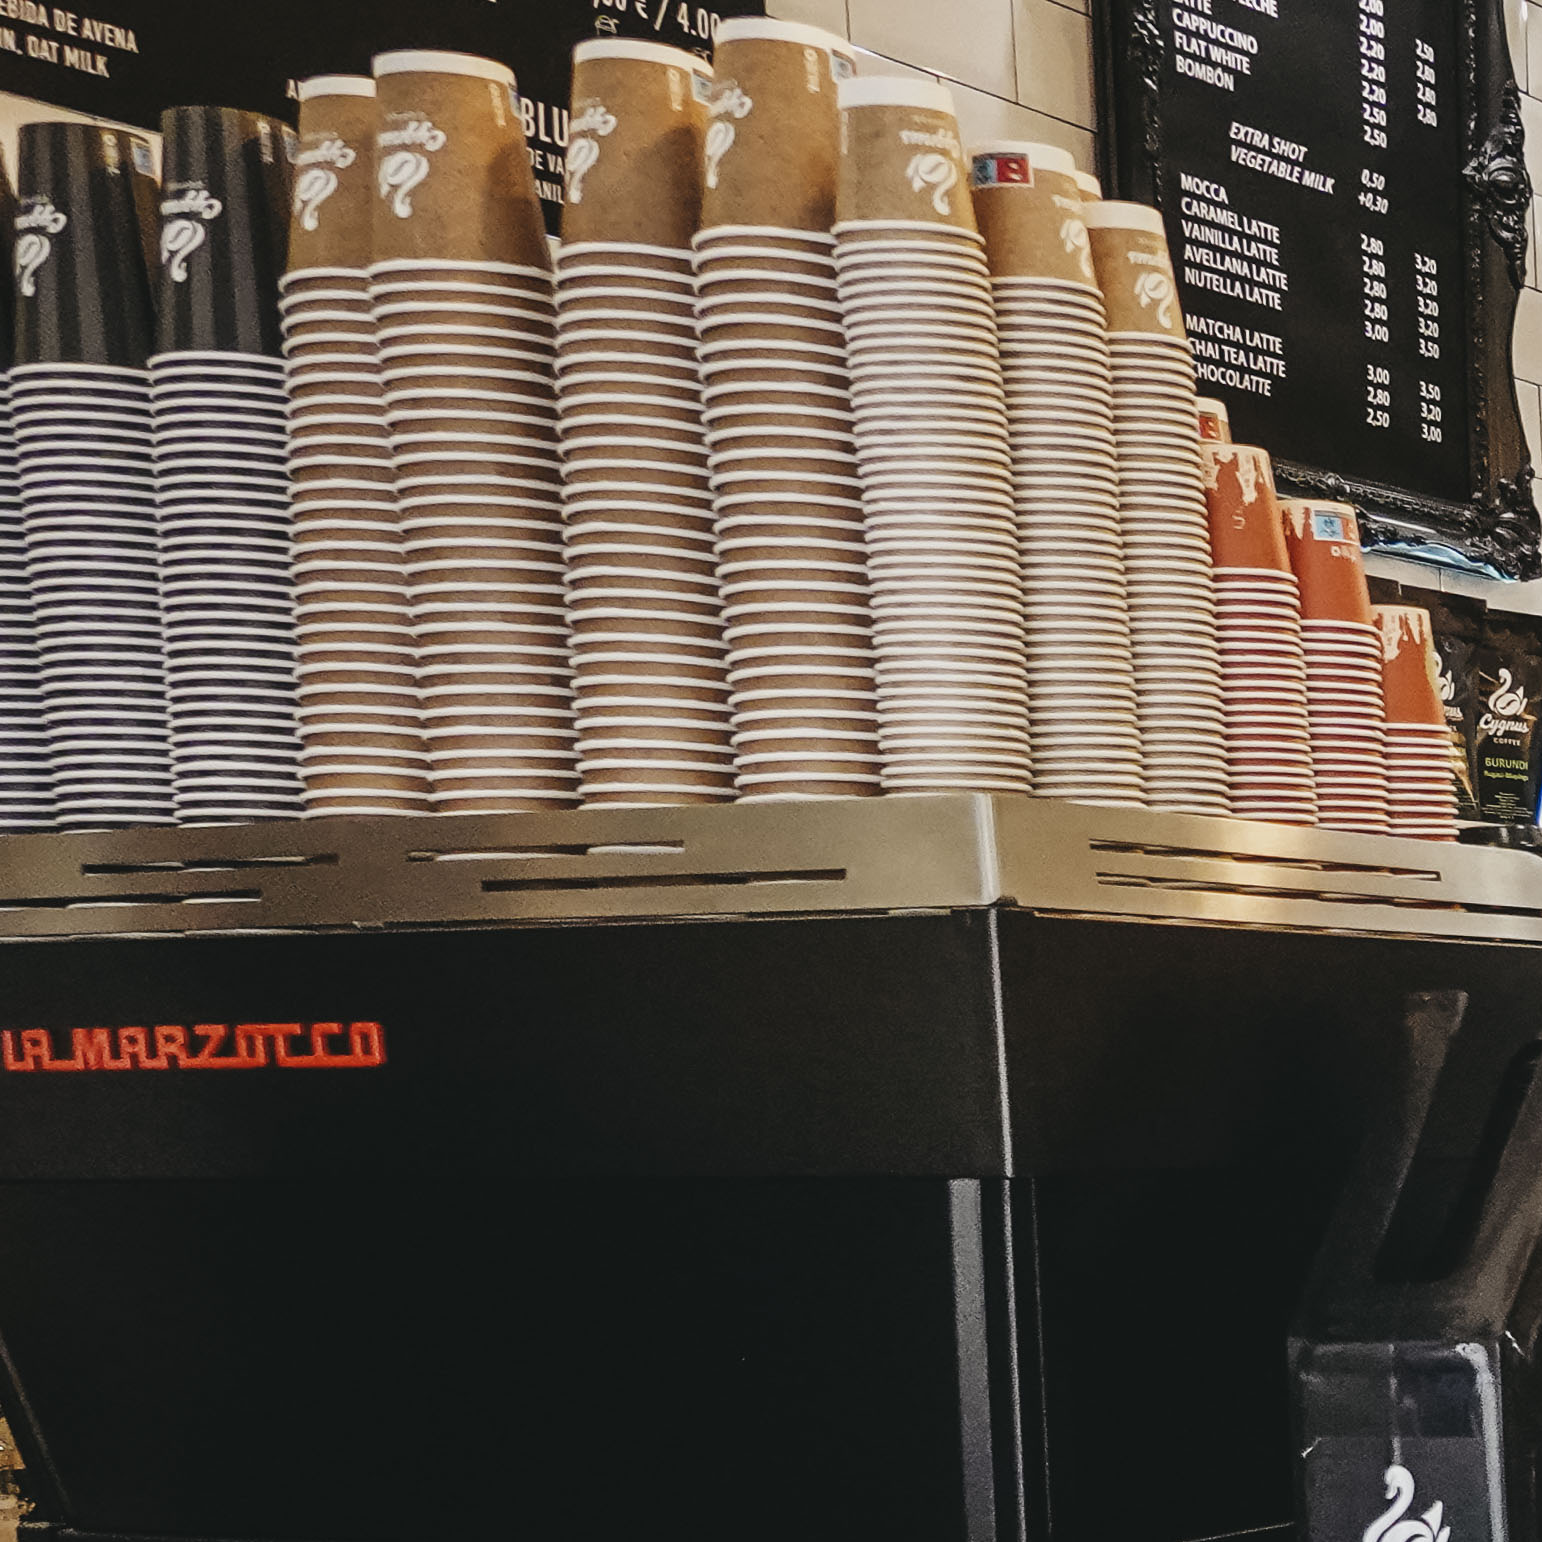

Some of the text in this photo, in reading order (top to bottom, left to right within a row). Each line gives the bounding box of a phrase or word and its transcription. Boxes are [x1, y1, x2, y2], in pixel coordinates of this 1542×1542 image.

[53, 8, 79, 36] DE
[81, 17, 139, 53] AVENA
[63, 44, 110, 78] MILK
[1173, 8, 1258, 54] CAPPUCCINO
[1362, 81, 1386, 104] 2,20
[1359, 14, 1385, 39] 2,00
[1360, 36, 1384, 60] 2,20
[1175, 31, 1386, 126] FLAT WHITE 2,50
[1176, 55, 1387, 148] BOMBÓN 2,50
[1361, 59, 1385, 82] 2,20
[1230, 122, 1385, 190] EXTRA SHOT 0,50
[1231, 145, 1388, 214] VEGETABLE MILK +0,30
[1181, 173, 1436, 274] MOCCA 2,80 3,20
[1182, 197, 1437, 295] CARAMEL LATTE 2,80 3,20
[1182, 220, 1438, 316] VAINILLA LATTE 2,80 3,20
[1184, 244, 1250, 278] AVELLANA
[1252, 264, 1288, 290] LATTE
[1365, 300, 1387, 320] 2,80
[1418, 317, 1439, 337] 3,20
[1185, 267, 1439, 358] NUTELLA LATTE 3,00 3,50
[1185, 313, 1440, 400] MATCHA LATTE 3,00 3,50
[1221, 345, 1247, 367] TEA
[1250, 352, 1286, 377] LATTE
[1367, 387, 1390, 406] 2,80
[1421, 402, 1441, 421] 3,20
[1367, 408, 1389, 427] 2,50
[1422, 424, 1441, 442] 3,00
[1479, 713, 1529, 736] Cygnus
[74, 1022, 387, 1070] MARZOCCO
